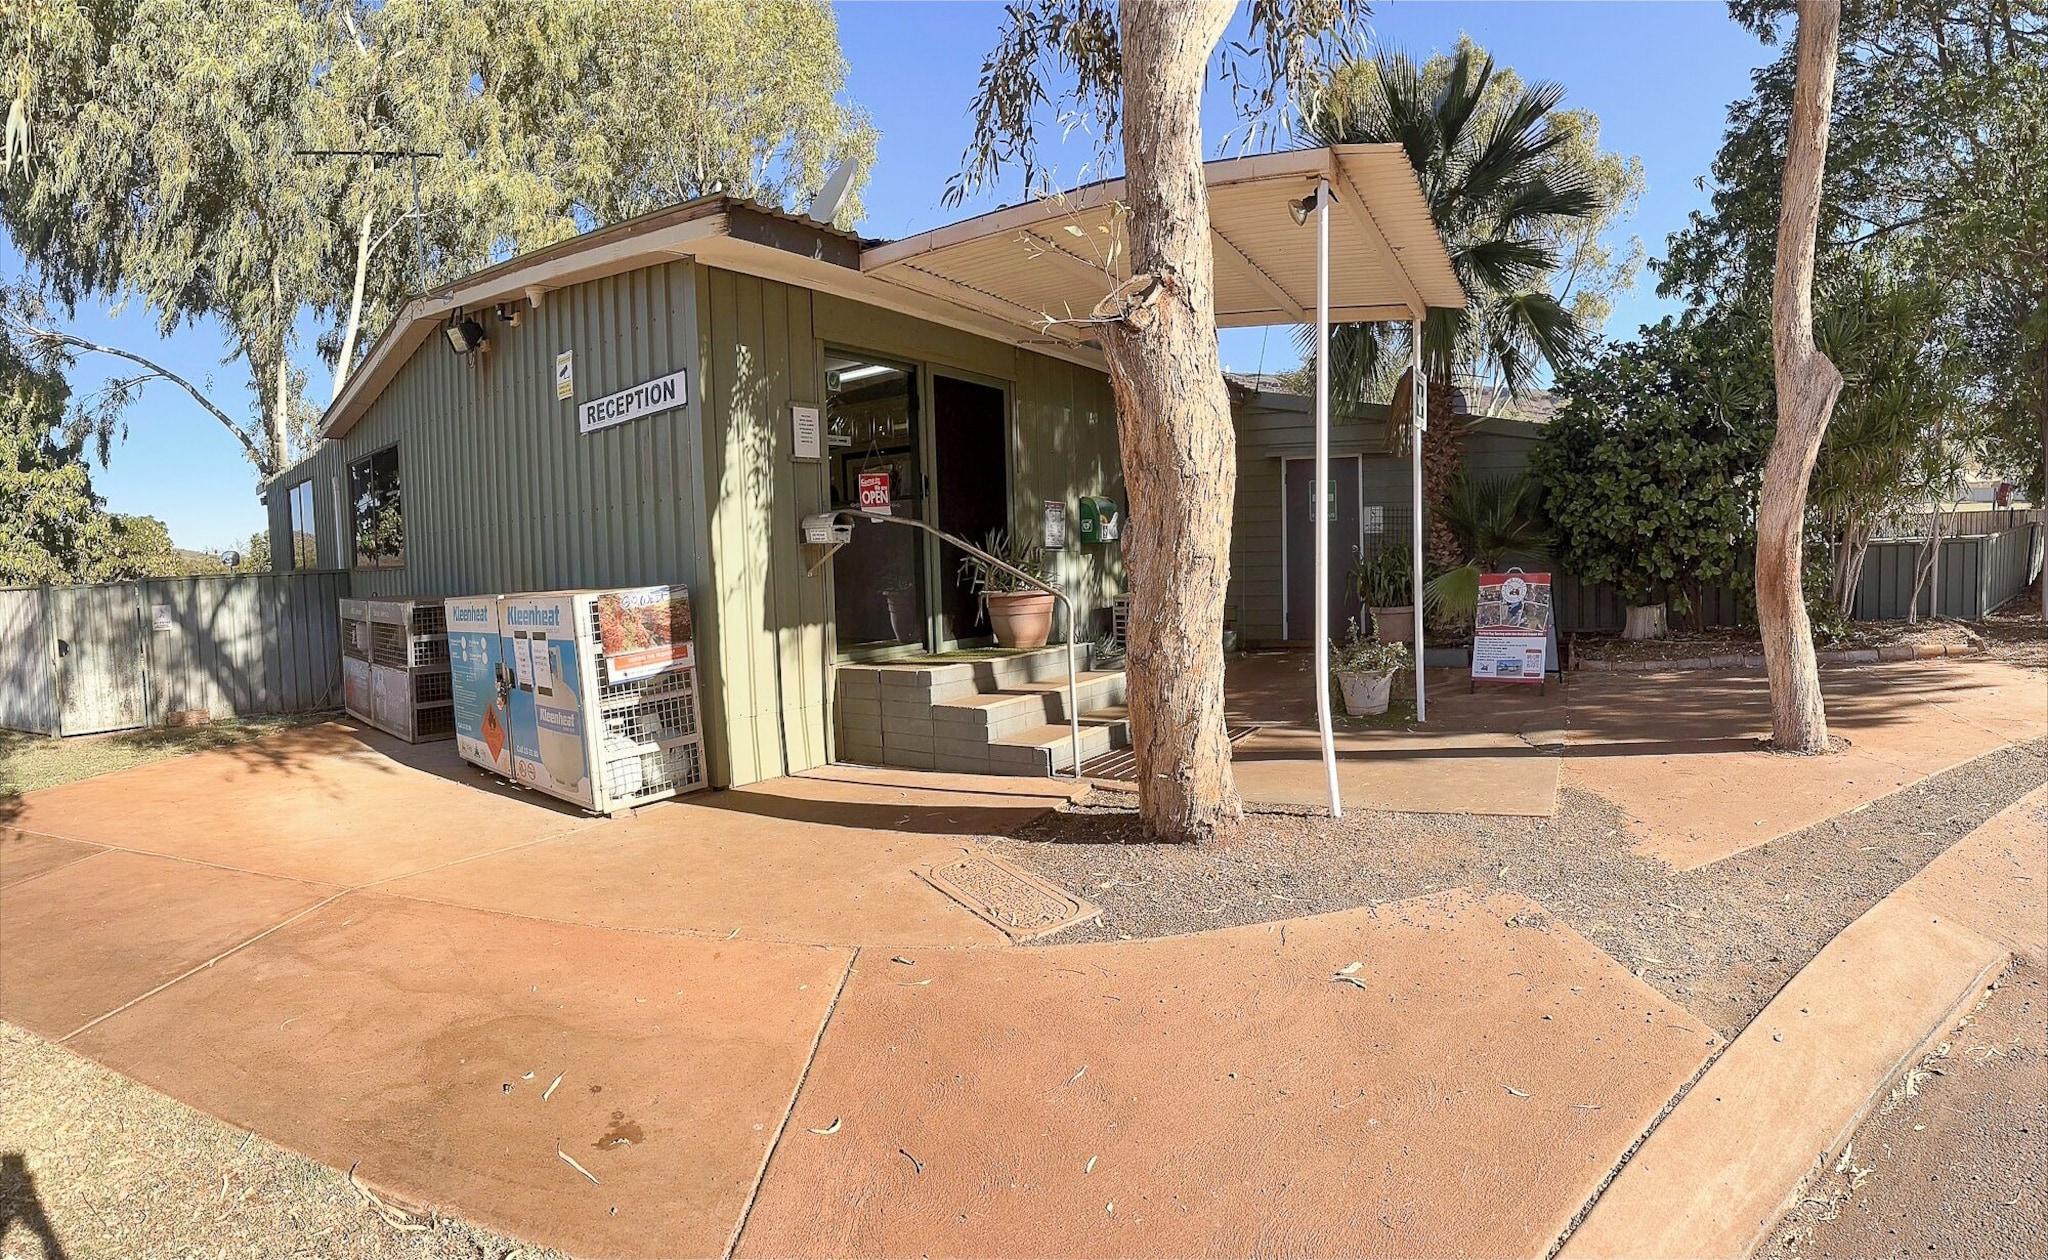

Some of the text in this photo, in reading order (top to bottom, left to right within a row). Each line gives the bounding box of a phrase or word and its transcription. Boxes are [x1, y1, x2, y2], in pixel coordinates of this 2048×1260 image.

[587, 378, 676, 425] RECEPTION
[862, 490, 889, 504] OPEN
[452, 605, 488, 622] Kleenheat
[507, 605, 560, 626] Kleenheat
[540, 708, 575, 727] Kleenheat
